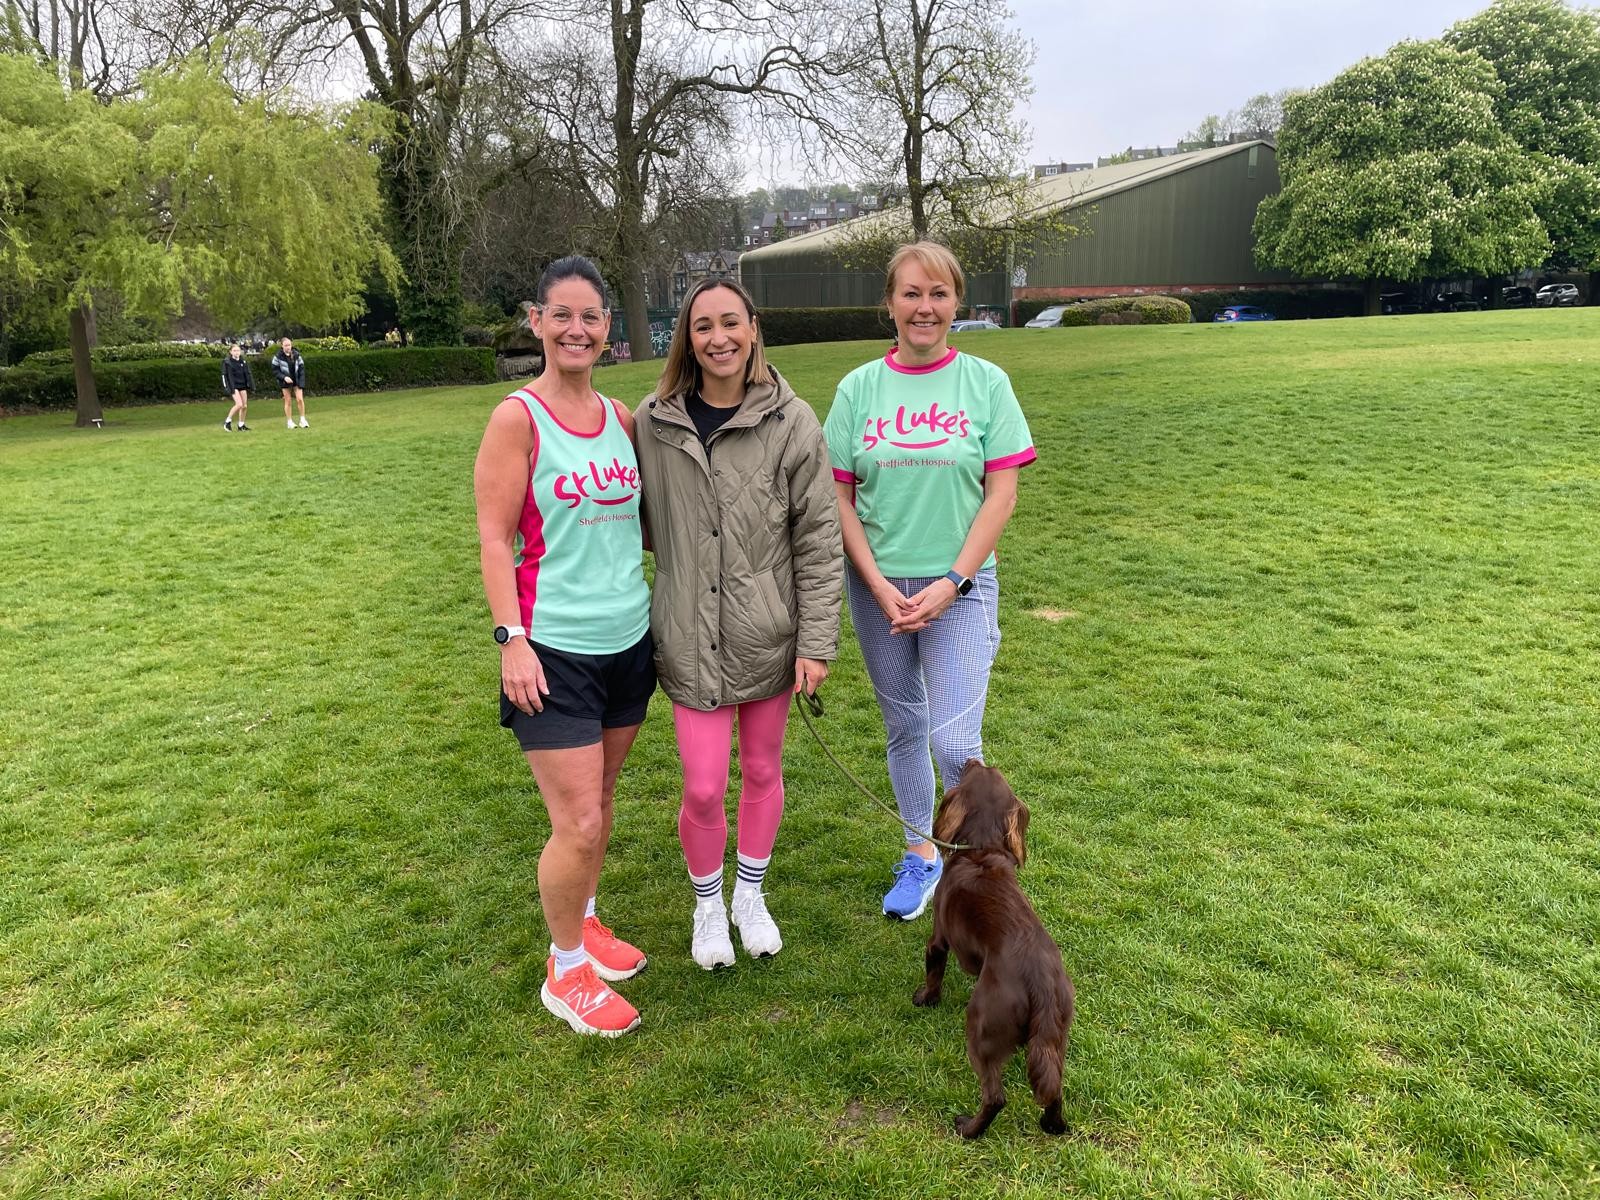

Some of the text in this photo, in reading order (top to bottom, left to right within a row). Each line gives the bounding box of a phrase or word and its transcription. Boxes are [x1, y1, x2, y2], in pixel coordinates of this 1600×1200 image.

[863, 402, 971, 450] St Luke's
[875, 458, 956, 468] Sheffield's Hospice
[553, 471, 591, 508] St
